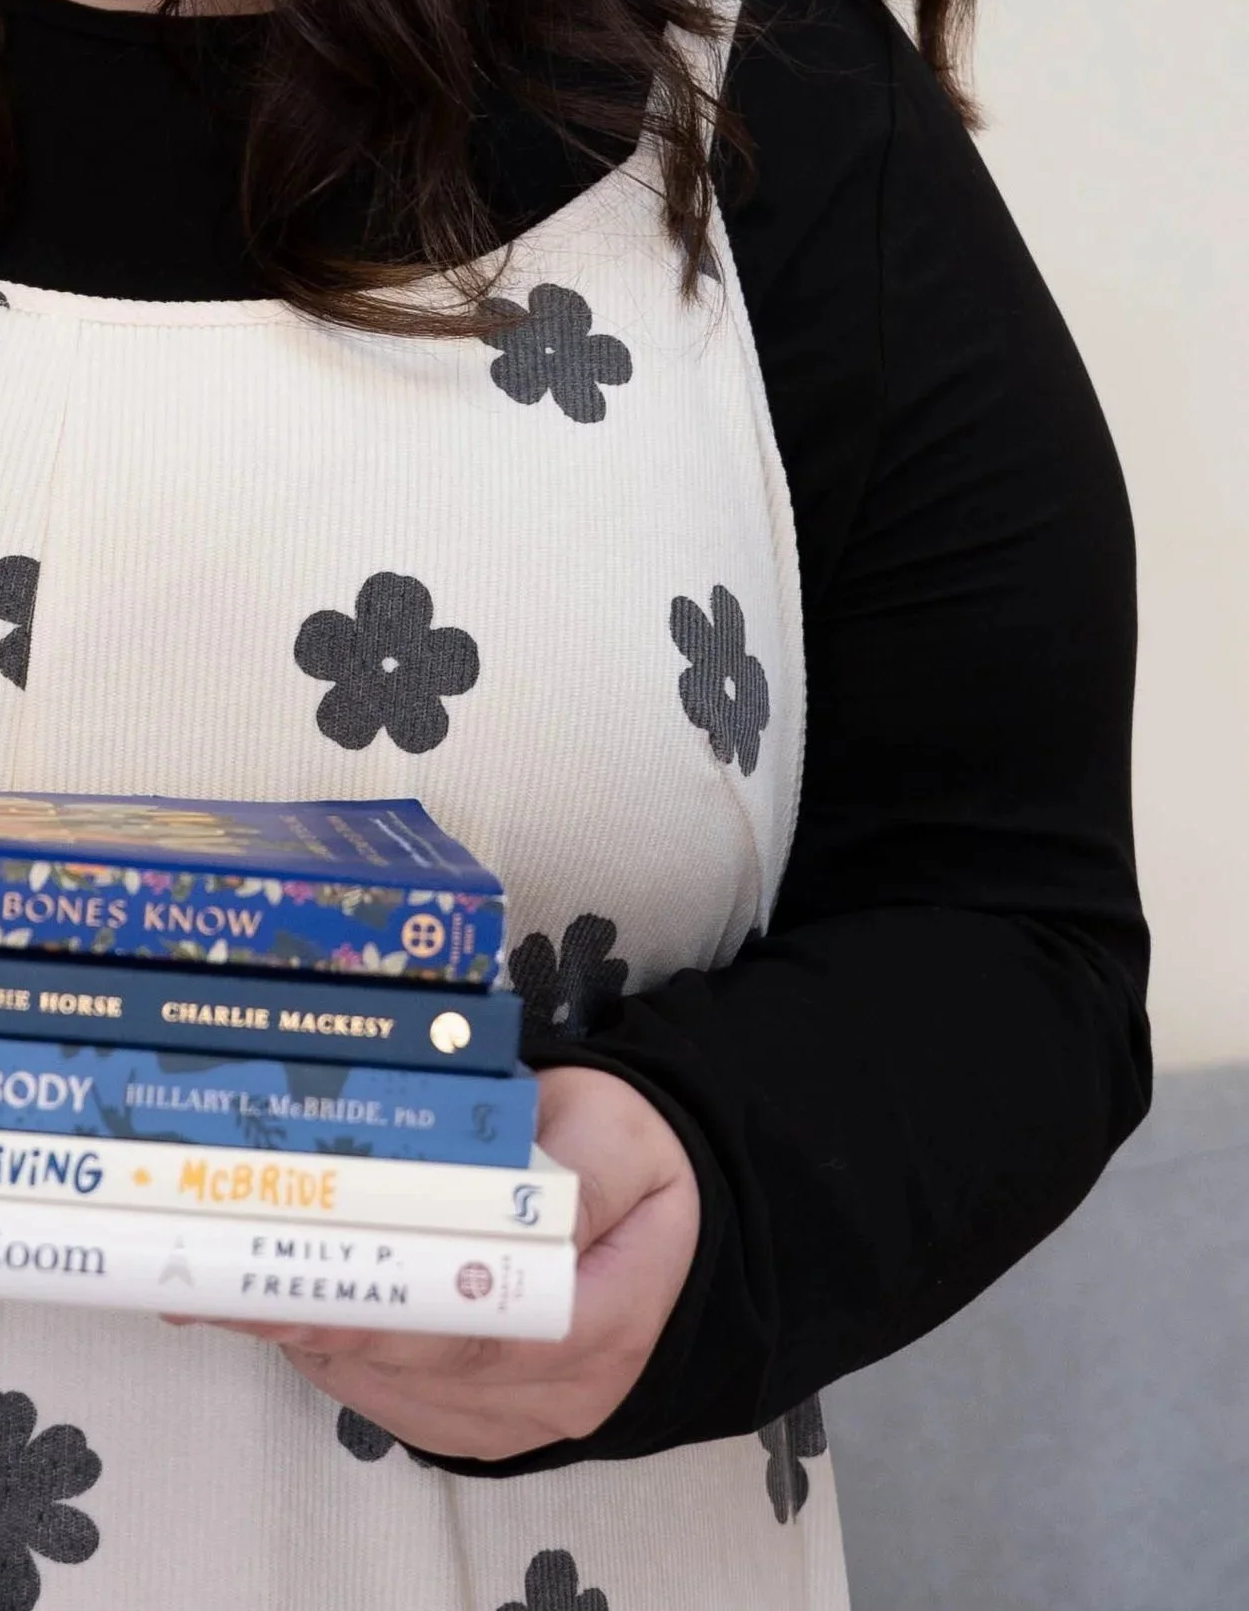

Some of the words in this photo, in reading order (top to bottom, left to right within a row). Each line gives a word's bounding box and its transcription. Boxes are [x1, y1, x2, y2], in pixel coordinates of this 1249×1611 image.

[2, 891, 128, 930] BONES
[144, 902, 263, 938] KNOW
[39, 991, 122, 1018] HORSE
[161, 1001, 270, 1030] CHARLIE
[278, 1010, 396, 1039] MACKESY
[126, 1083, 236, 1114] HILLARY
[239, 1092, 261, 1117] L.
[394, 1106, 436, 1130] PhD
[251, 1236, 354, 1262] EMILY
[376, 1245, 404, 1266] P.
[240, 1272, 409, 1305] FREEMAN
